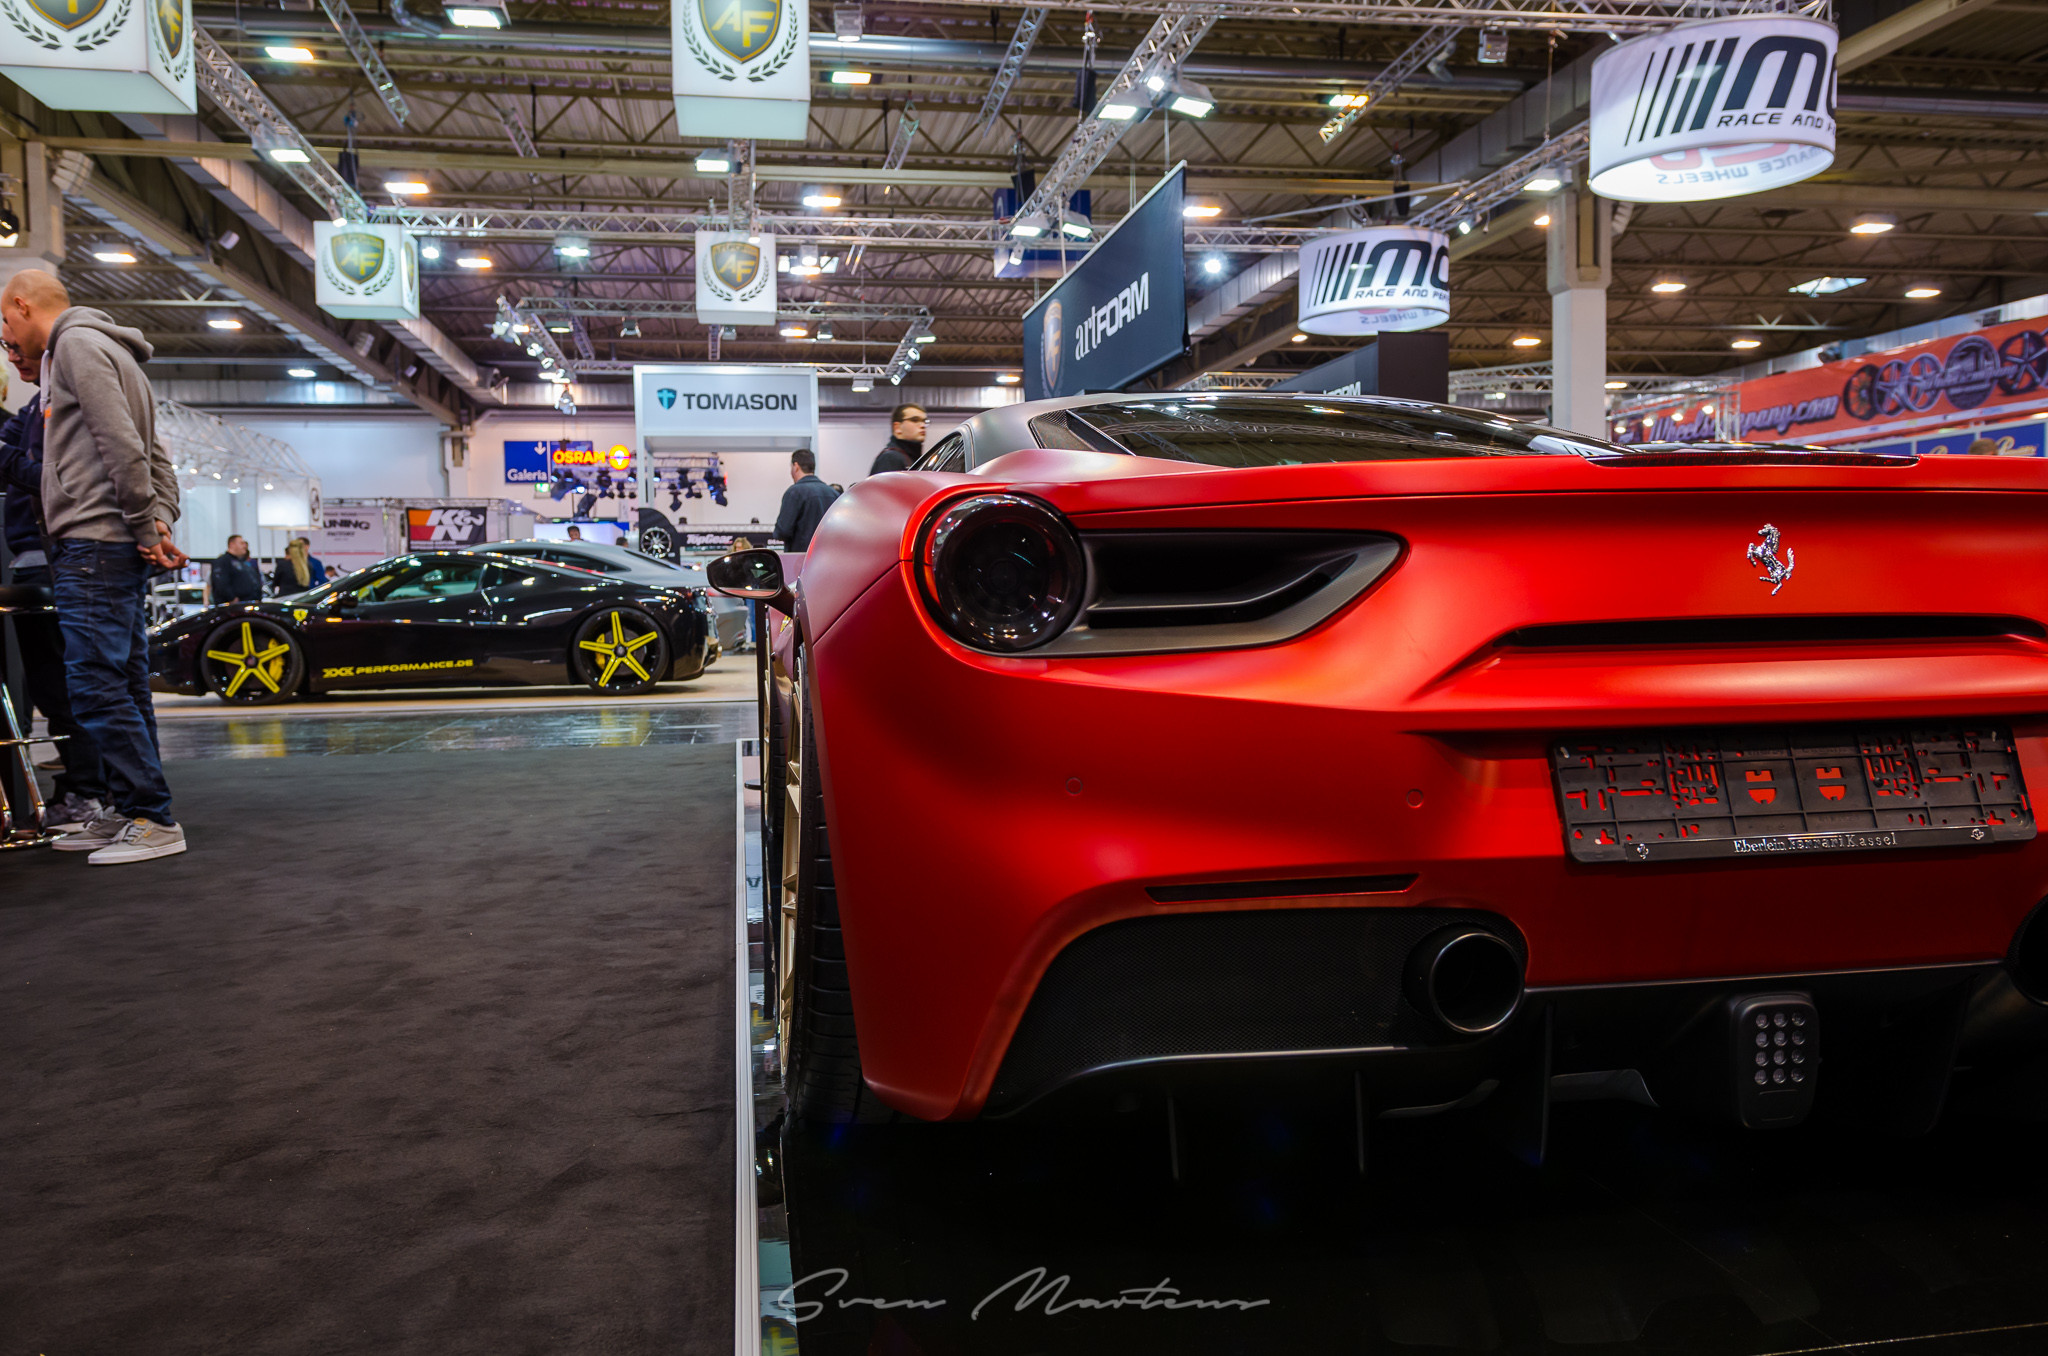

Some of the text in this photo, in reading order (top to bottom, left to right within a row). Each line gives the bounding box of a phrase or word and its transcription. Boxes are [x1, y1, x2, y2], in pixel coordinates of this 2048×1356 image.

[711, 0, 775, 48] AF
[1717, 112, 1783, 128] RACE
[1792, 115, 1823, 129] AND
[718, 254, 756, 283] AF
[1354, 288, 1397, 299] RACE
[1402, 288, 1429, 298] AND
[1075, 271, 1149, 361] artFORM
[684, 393, 798, 412] TOMASON
[552, 450, 606, 465] OSRAM
[507, 468, 548, 482] Galeria
[323, 519, 370, 530] UNING
[427, 509, 485, 542] K&N
[356, 658, 474, 675] PERFORMANCE.DE
[1733, 838, 1787, 853] Eberlein
[1845, 832, 1898, 847] Kassel
